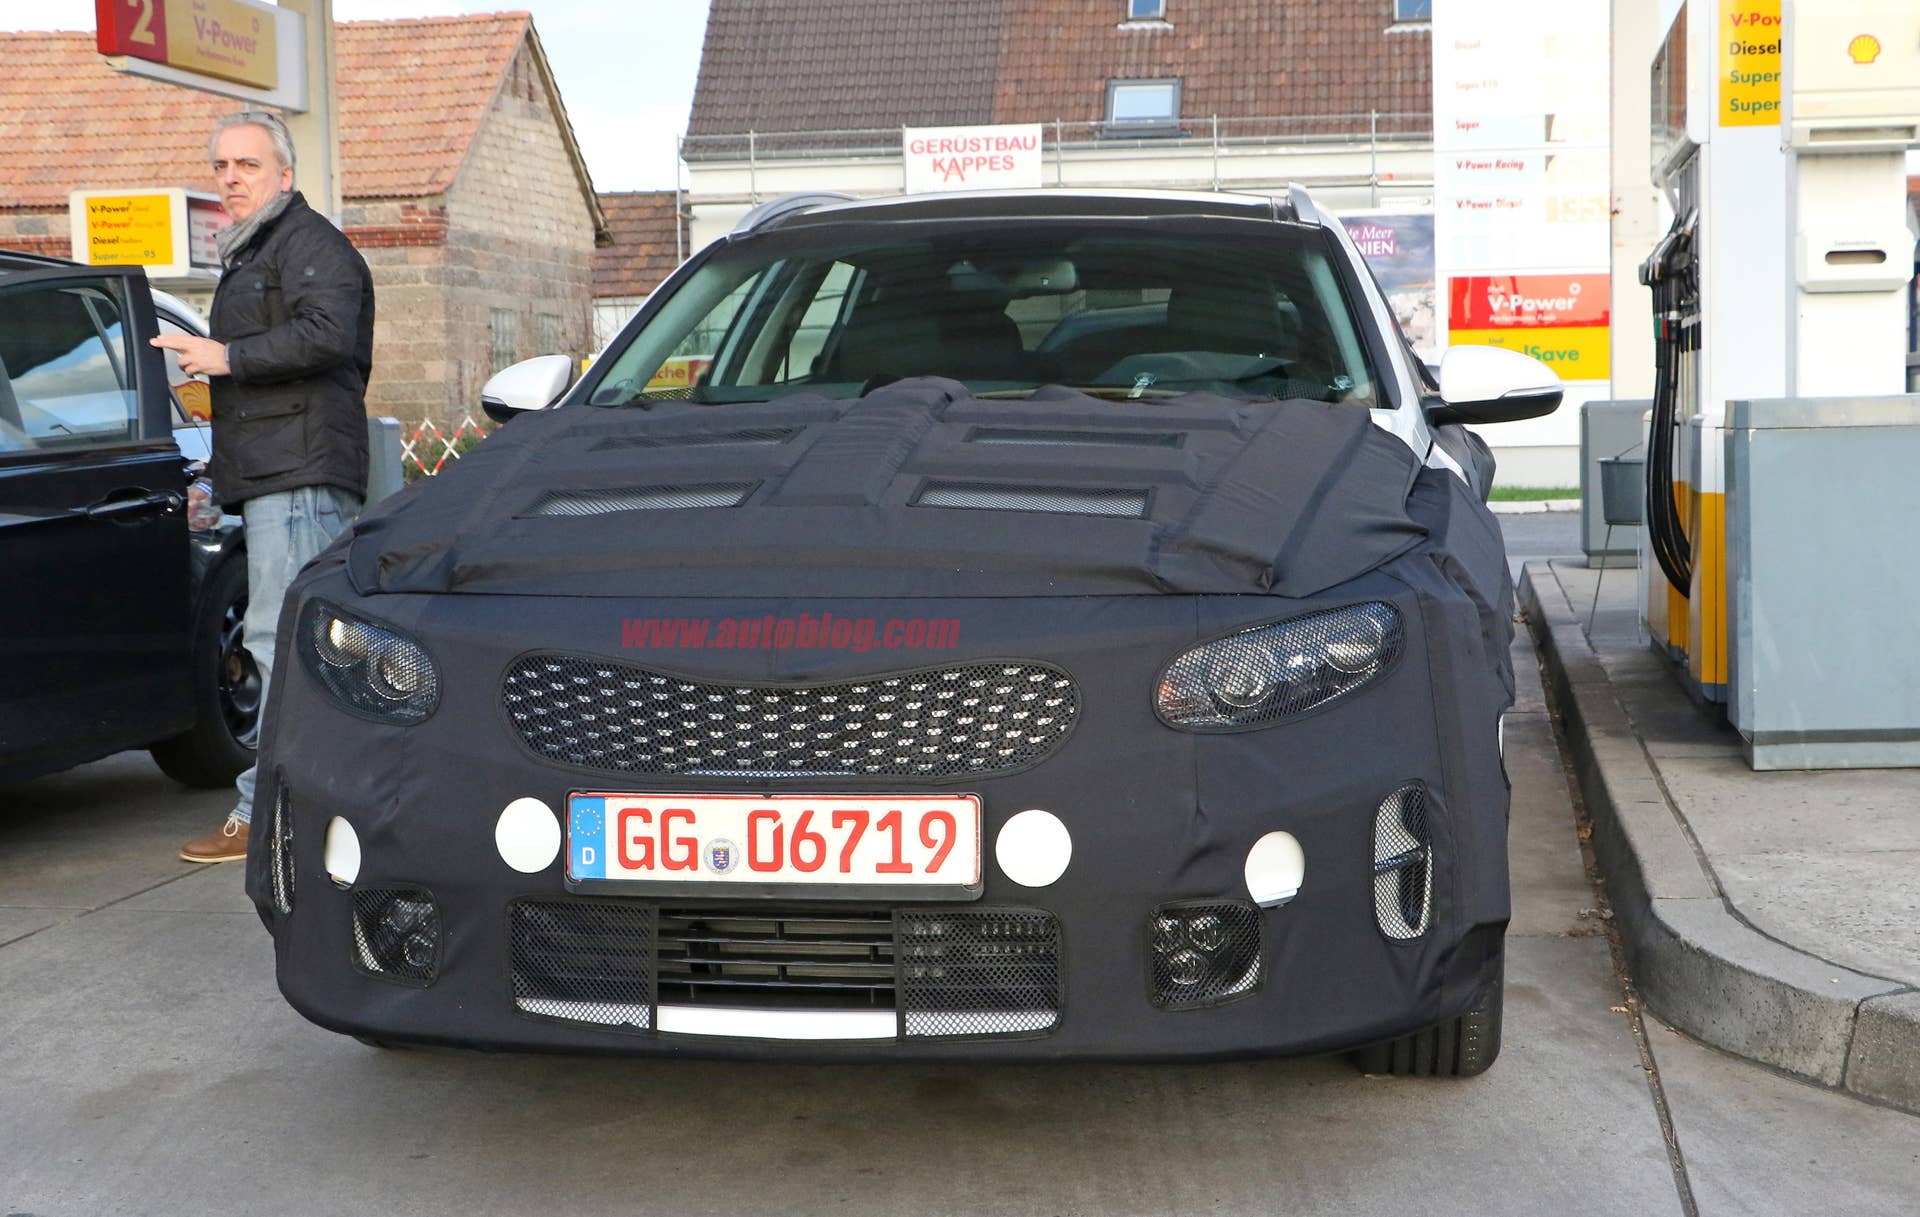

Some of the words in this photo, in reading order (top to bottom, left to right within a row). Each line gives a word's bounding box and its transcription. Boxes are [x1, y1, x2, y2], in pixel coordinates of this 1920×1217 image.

[127, 0, 156, 45] 2
[193, 15, 257, 55] V-Power
[1729, 38, 1781, 56] Diesel
[1729, 69, 1781, 87] Super
[1729, 97, 1781, 115] Super
[1455, 120, 1480, 132] Super
[909, 134, 1038, 155] GERÜSTBAU
[932, 155, 1016, 182] KAPPES
[1456, 160, 1493, 171] V-Power
[1495, 159, 1525, 171] Racing
[90, 204, 130, 214] V-Power
[1456, 199, 1493, 209] V-Power
[92, 220, 131, 229] V-Power
[1362, 226, 1394, 240] Meer
[93, 236, 119, 245] Diesel
[93, 253, 119, 261] Super
[1487, 293, 1577, 312] V-Power
[617, 808, 699, 872] GG
[747, 809, 957, 873] 06719
[582, 846, 596, 866] D
